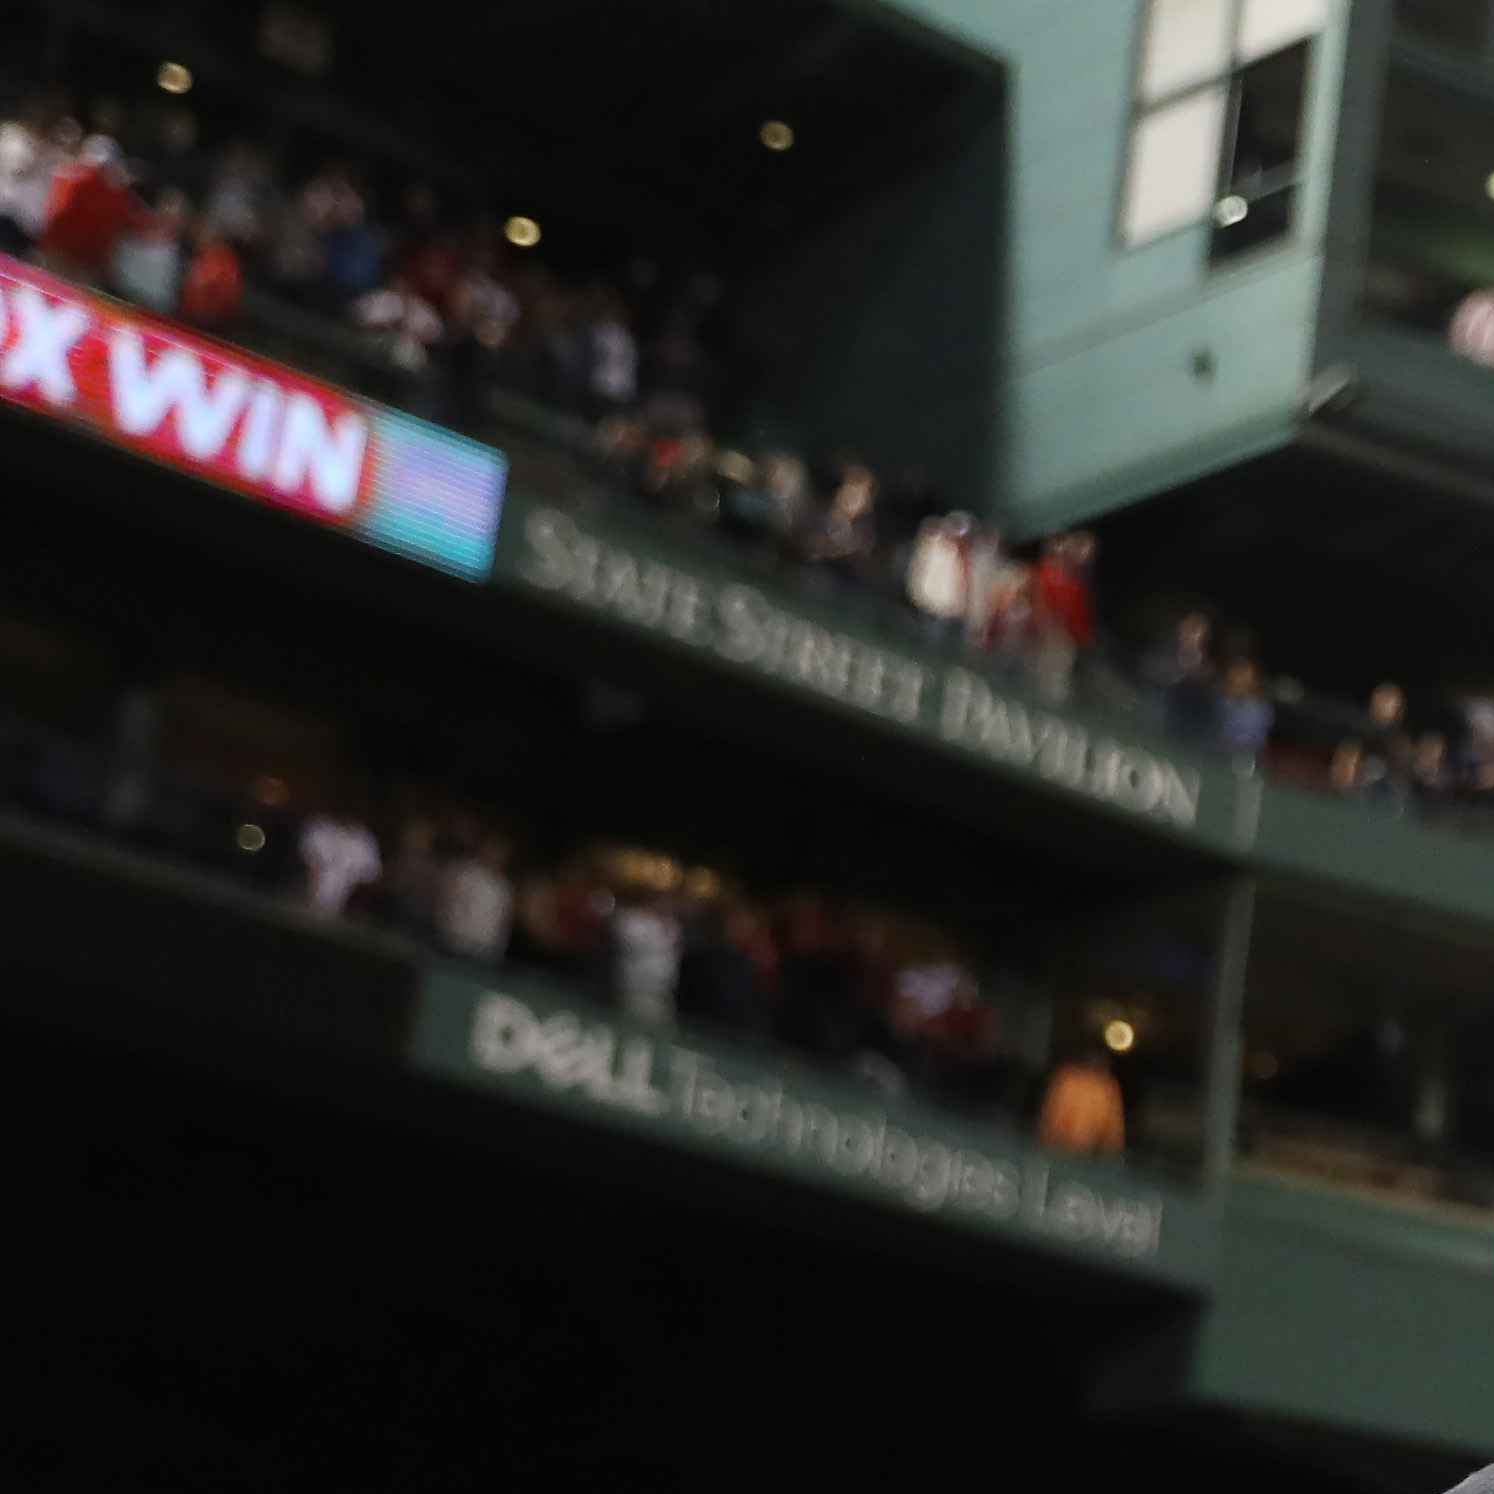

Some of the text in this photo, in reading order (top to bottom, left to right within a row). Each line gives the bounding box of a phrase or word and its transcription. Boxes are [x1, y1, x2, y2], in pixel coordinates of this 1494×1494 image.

[0, 284, 367, 511] X WIN
[474, 995, 1161, 1257] DELL Technologies Level
